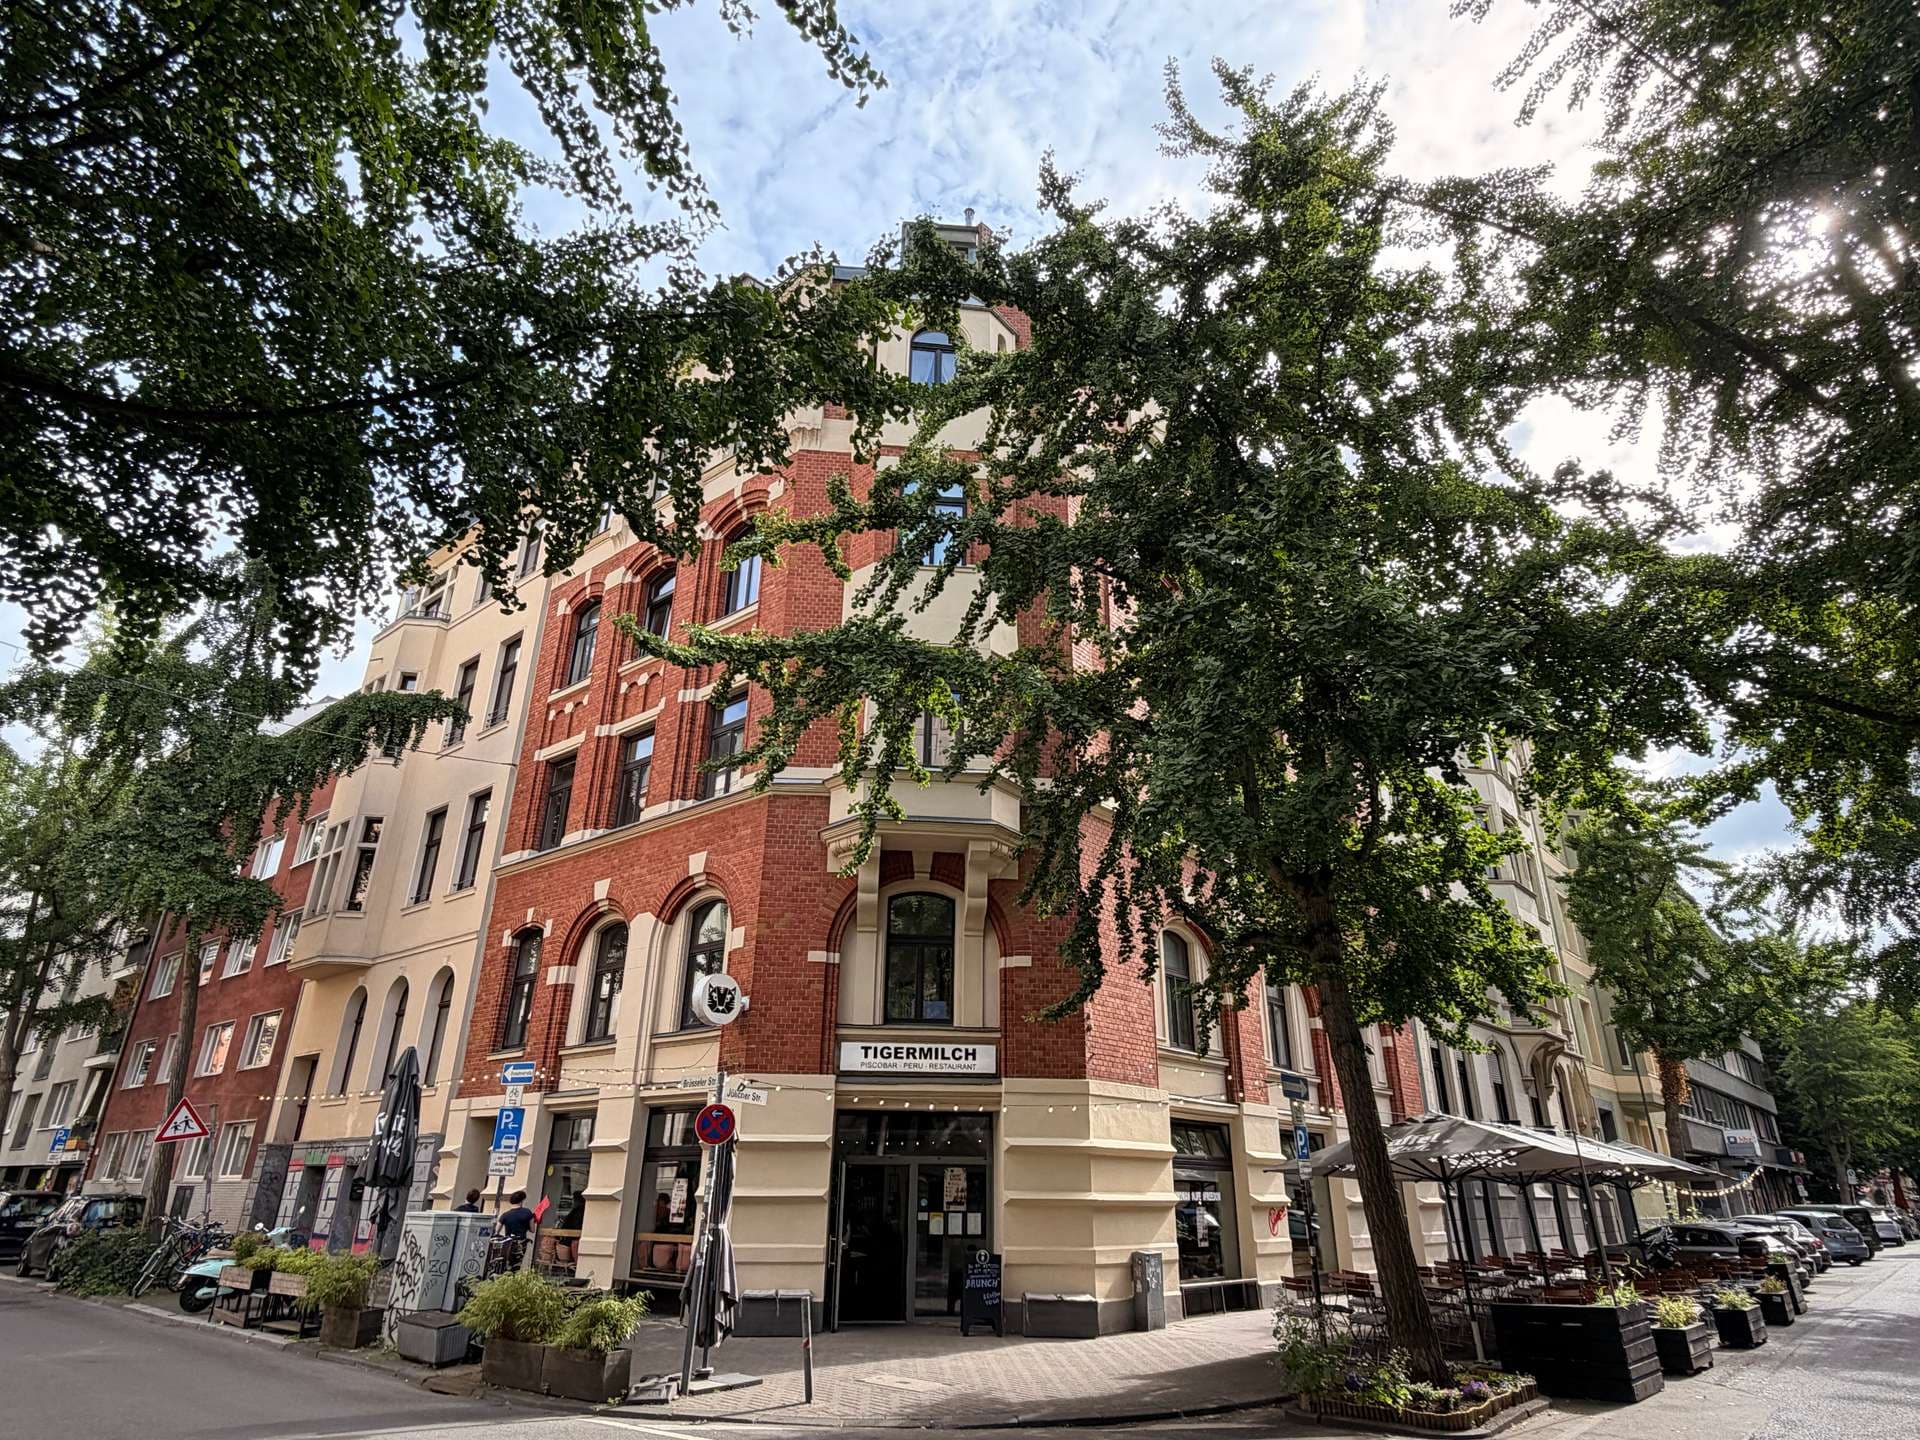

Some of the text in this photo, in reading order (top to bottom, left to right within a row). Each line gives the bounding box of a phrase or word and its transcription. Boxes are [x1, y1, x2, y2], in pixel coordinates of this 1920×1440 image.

[861, 1046, 977, 1061] TIGERMILCH
[860, 1061, 977, 1071] PISCOBAR PERU RESTAURANT
[751, 1092, 763, 1102] Str.
[501, 1111, 514, 1129] P
